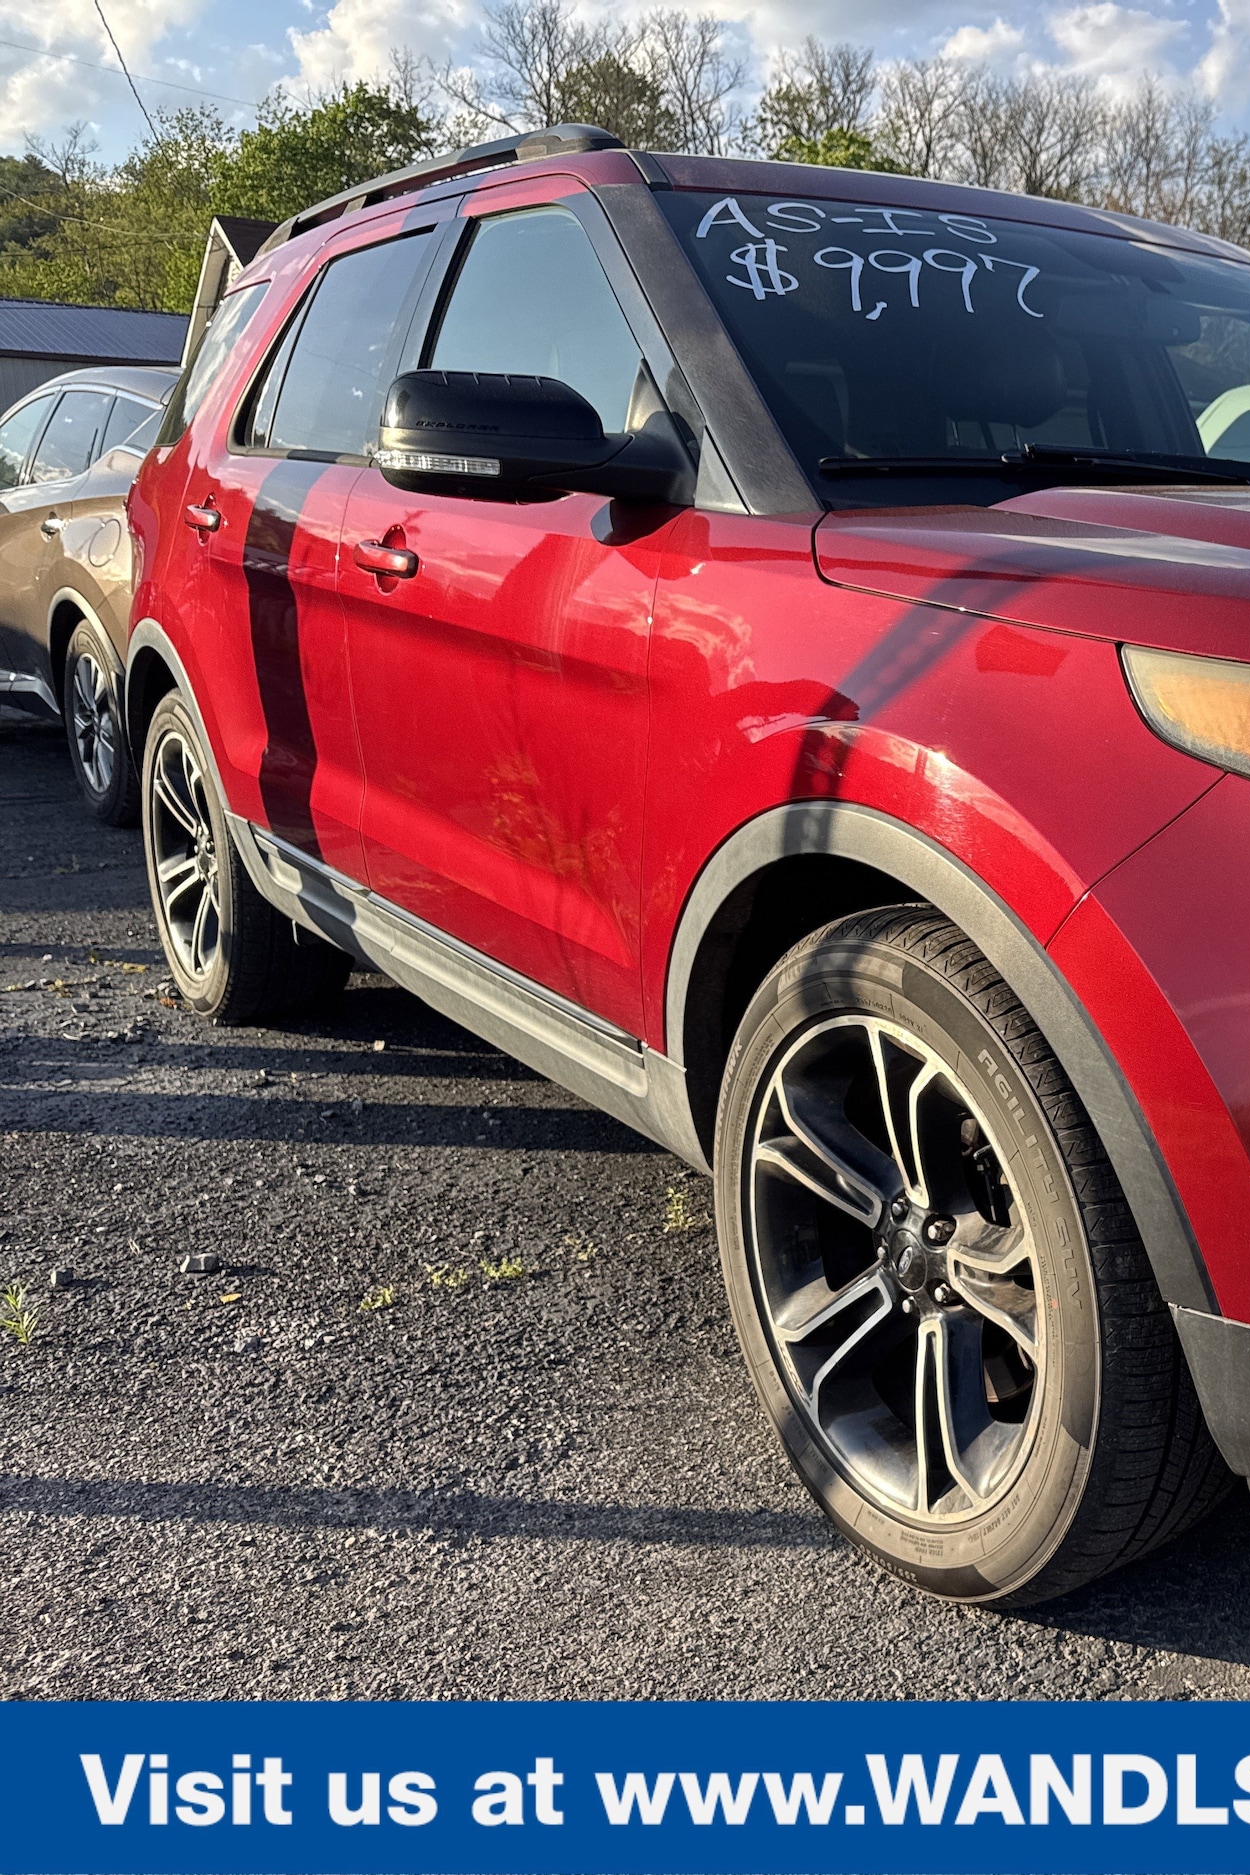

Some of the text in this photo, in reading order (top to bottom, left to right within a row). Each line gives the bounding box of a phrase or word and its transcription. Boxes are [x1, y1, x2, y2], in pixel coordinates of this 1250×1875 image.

[696, 197, 998, 244] AS-IS
[416, 420, 500, 431] EXPLORER
[977, 1048, 1083, 1310] AGILITY SUV
